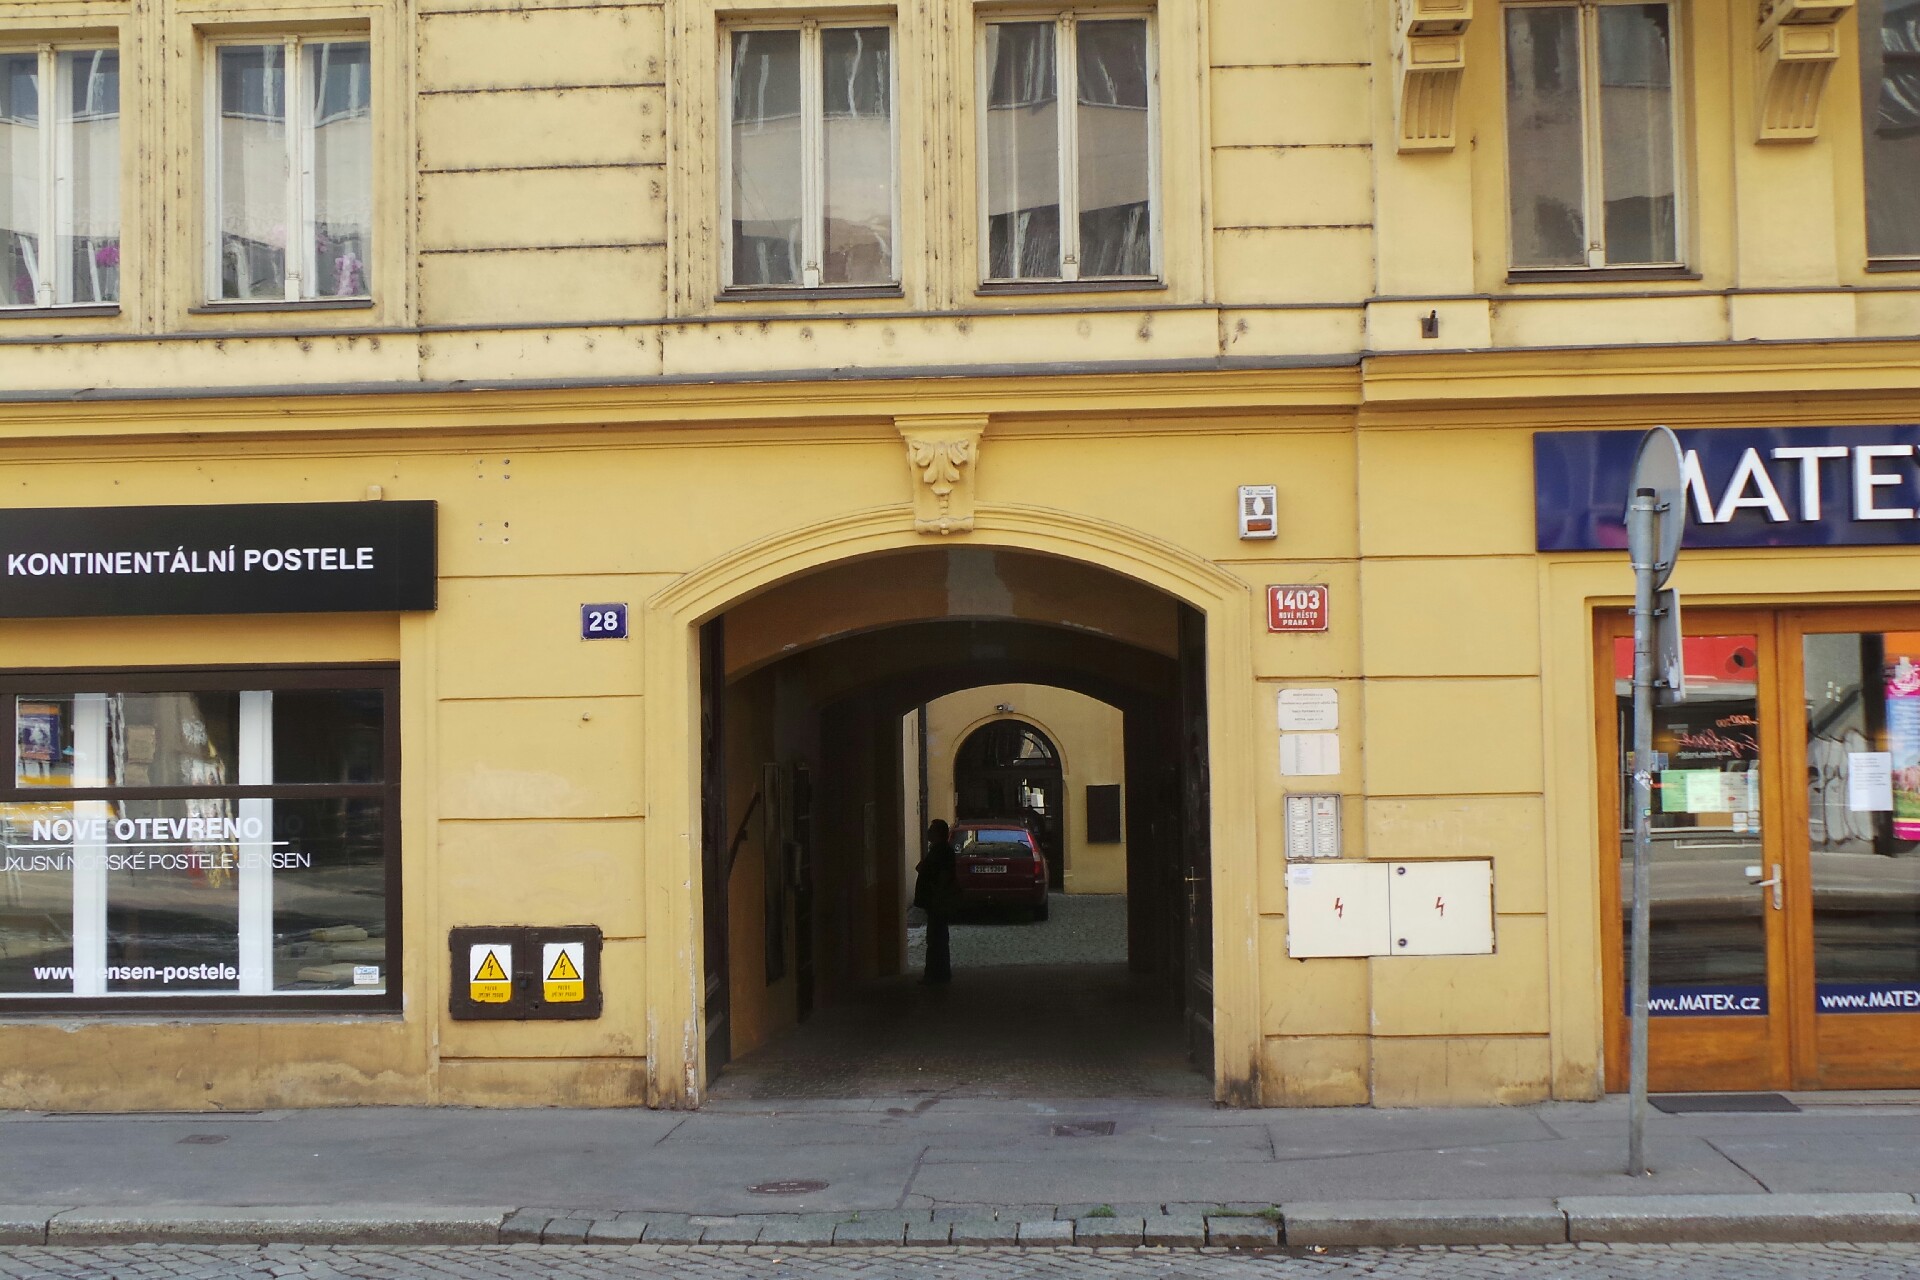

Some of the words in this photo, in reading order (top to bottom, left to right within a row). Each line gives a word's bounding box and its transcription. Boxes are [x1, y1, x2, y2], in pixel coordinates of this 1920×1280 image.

[1683, 444, 1920, 524] ATE
[8, 545, 235, 576] KONTINENTÁLNÍ
[244, 547, 374, 571] POSTELE
[1276, 590, 1320, 610] 1403
[589, 611, 618, 631] 28
[1279, 610, 1294, 619] NOVÉ
[1296, 610, 1318, 619] MĚSTO
[115, 813, 263, 841] OTEVŘENO
[149, 853, 233, 870] POSTELE
[1647, 994, 1761, 1010] ww.MATEX.cz
